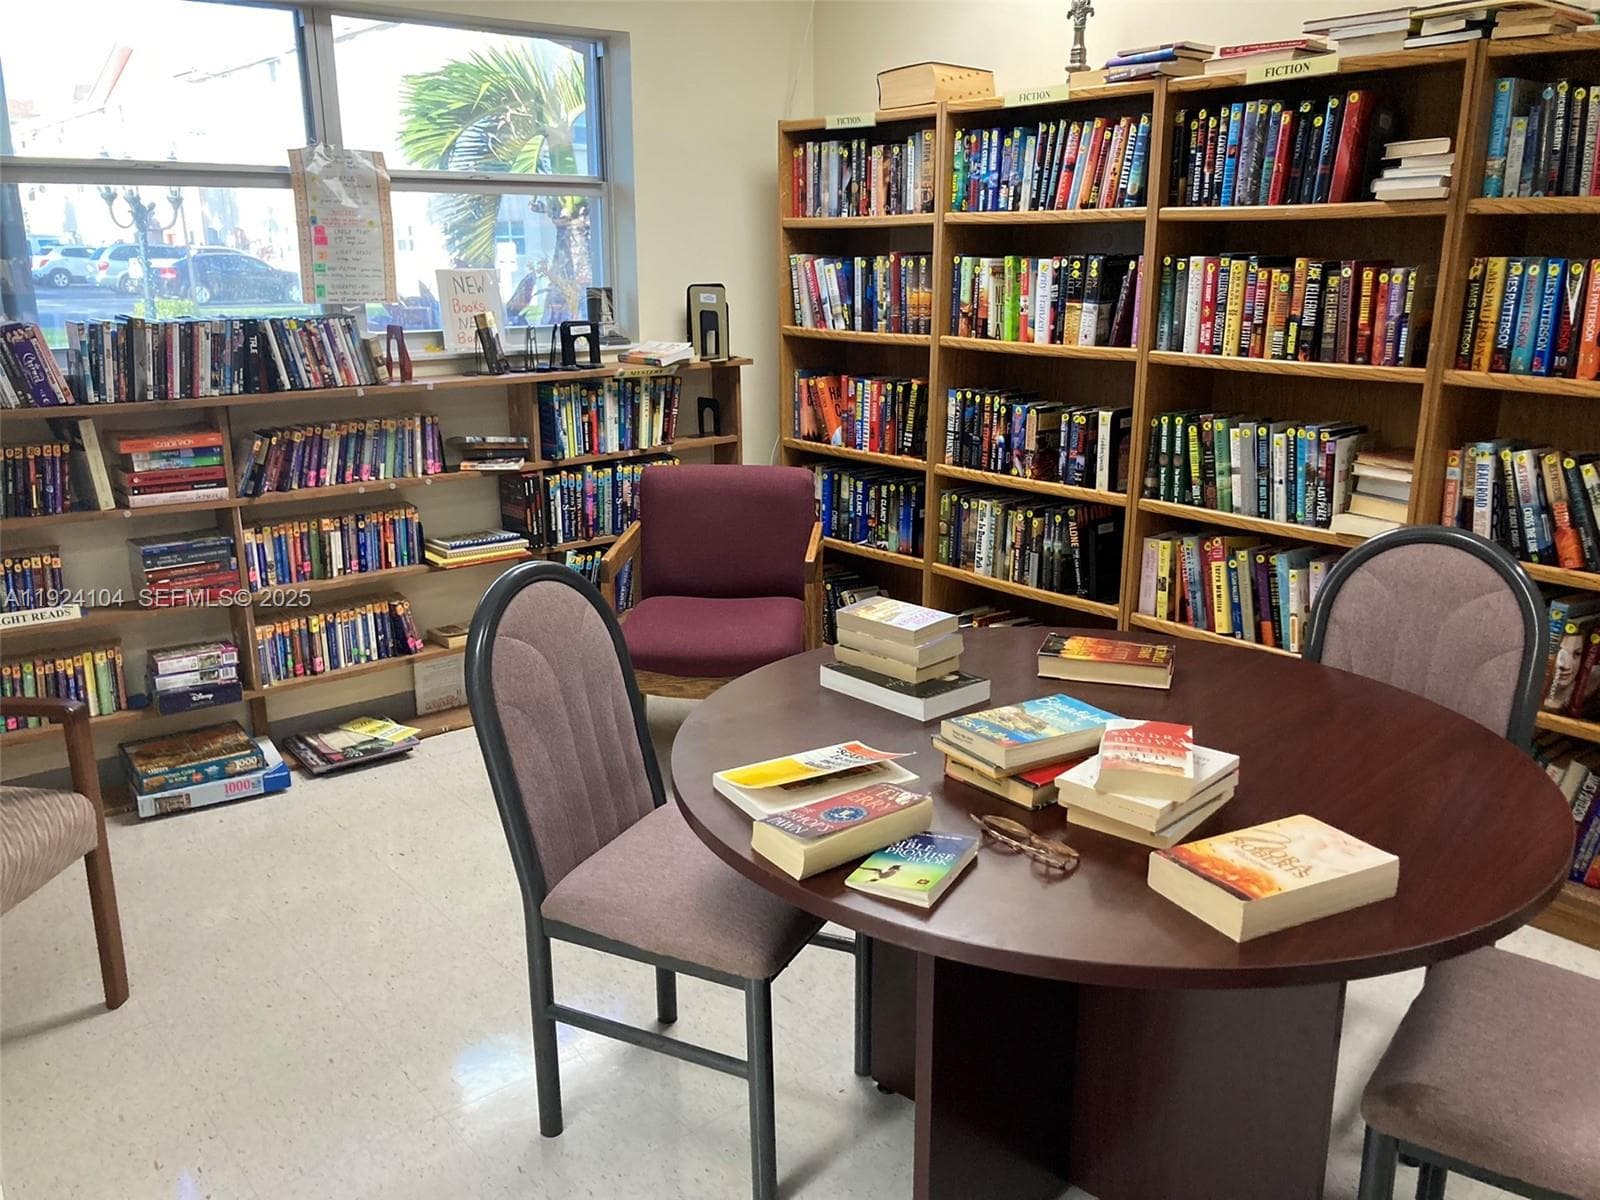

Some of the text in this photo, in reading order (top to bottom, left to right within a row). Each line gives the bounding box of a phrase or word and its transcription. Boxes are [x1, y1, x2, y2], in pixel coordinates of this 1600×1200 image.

[1264, 62, 1311, 78] FICTION
[1018, 90, 1051, 102] FICTION
[836, 117, 861, 126] FICTION
[1217, 135, 1227, 153] GOOD
[1120, 161, 1131, 188] DEAVER
[1581, 140, 1594, 189] Maddow
[1192, 167, 1201, 201] OVERBOARD
[452, 274, 485, 295] NEW
[452, 298, 486, 314] Books
[1037, 272, 1048, 332] urity Franzen
[1213, 272, 1228, 345] KELLERMAN FORGOTTEN
[1253, 289, 1267, 324] KELLERMAN
[1301, 284, 1319, 327] KELLERMAN
[1324, 293, 1339, 334] KELLERMAN
[1460, 283, 1480, 355] JAMES PATTERSON
[1497, 293, 1514, 349] PATTERSON
[1517, 292, 1533, 348] PATTERSON
[1536, 295, 1555, 351] PATTERSON
[1585, 293, 1599, 342] PATTERSON
[1241, 321, 1251, 348] MYSTERY
[1476, 295, 1494, 356] PATTERSON
[1272, 331, 1283, 355] MOTIVE
[1555, 356, 1567, 368] 10
[1316, 487, 1326, 502] LAST
[1476, 464, 1489, 507] BEACH ROAD
[1316, 503, 1326, 521] PLACE
[1524, 508, 1535, 527] CROSS
[1068, 521, 1079, 548] ALONE
[1528, 528, 1536, 539] THE
[1529, 540, 1538, 553] LINE
[1, 608, 71, 626] GHT READS
[1114, 735, 1183, 748] BROWN
[234, 755, 257, 769] 1000
[224, 779, 251, 794] 1000
[766, 816, 810, 834] PAWN
[886, 846, 956, 861] PROMISE
[906, 855, 949, 866] BOOK
